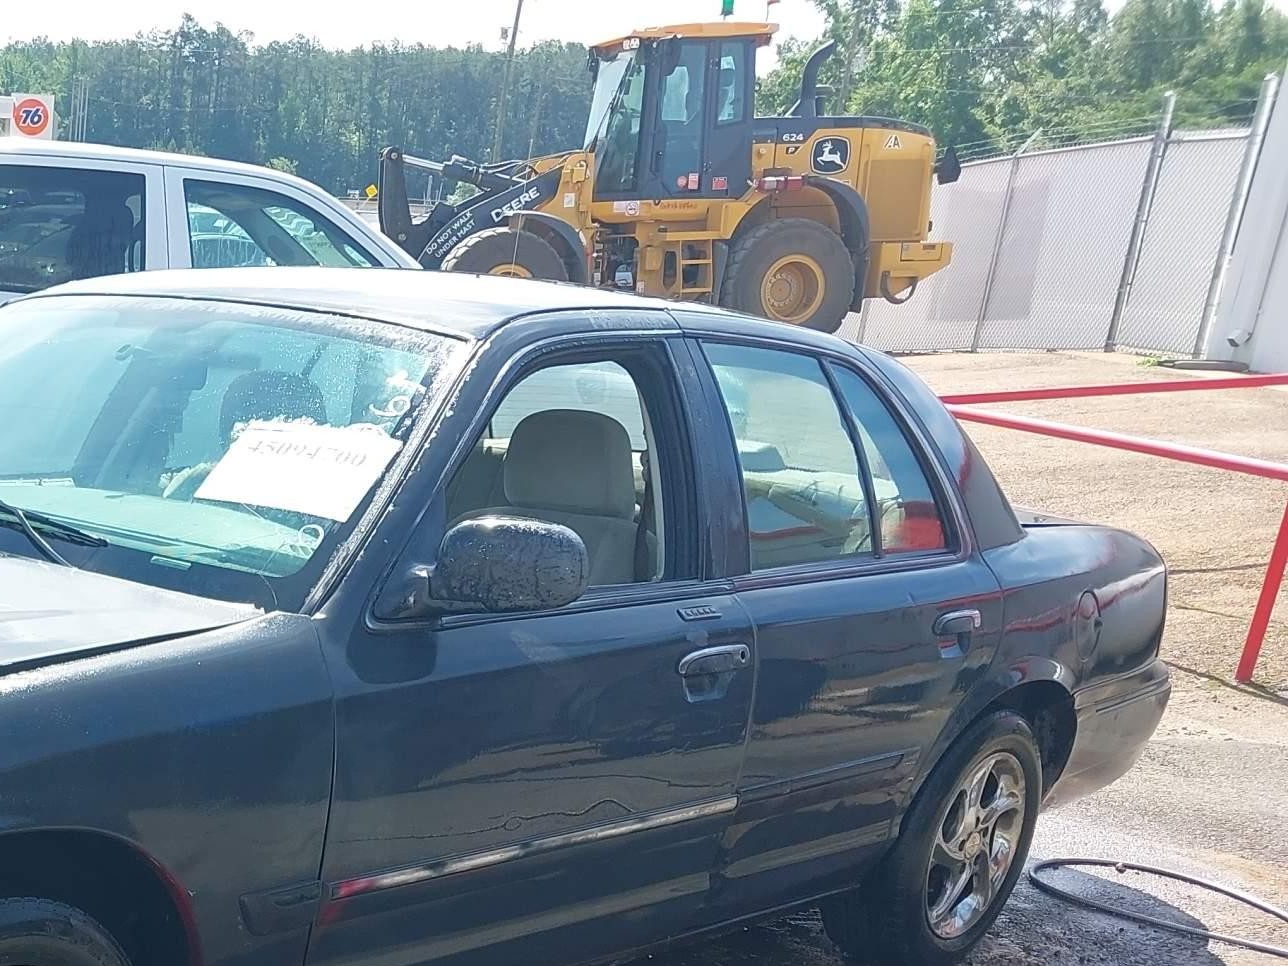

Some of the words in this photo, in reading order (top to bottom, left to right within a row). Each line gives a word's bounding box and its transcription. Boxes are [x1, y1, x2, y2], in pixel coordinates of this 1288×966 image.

[19, 106, 44, 127] 76
[782, 133, 804, 142] 624
[490, 186, 541, 222] DEERE
[426, 243, 438, 255] DO
[438, 228, 453, 243] NOT
[452, 210, 473, 230] WALK
[434, 235, 459, 258] UNDER
[457, 219, 476, 238] MAST
